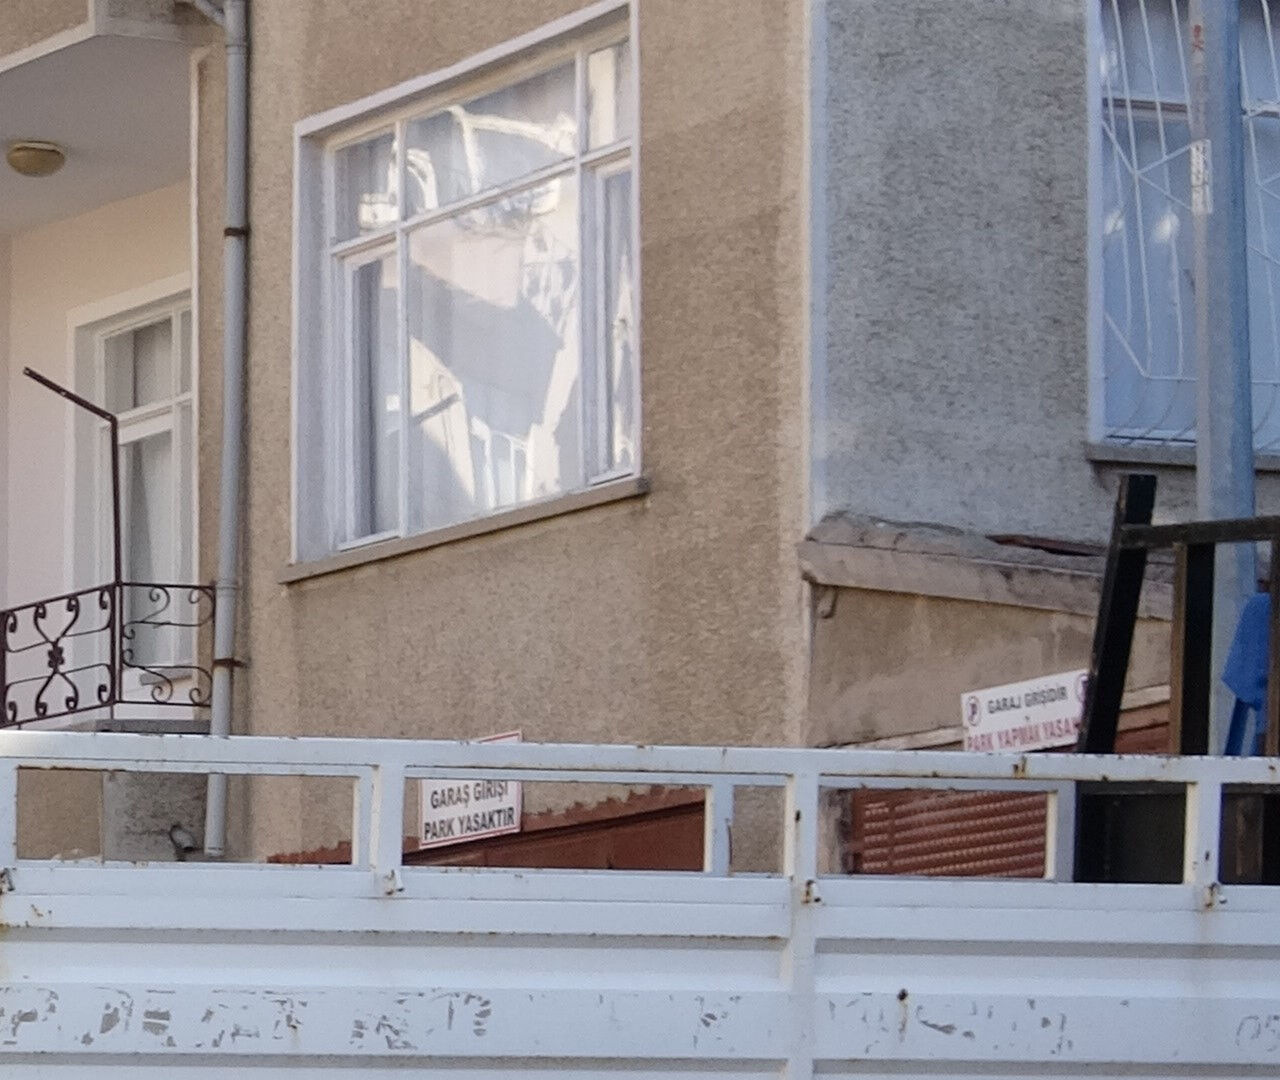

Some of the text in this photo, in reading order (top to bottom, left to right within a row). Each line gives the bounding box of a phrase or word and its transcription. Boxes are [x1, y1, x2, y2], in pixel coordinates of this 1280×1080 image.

[987, 697, 1022, 714] GARAJ
[967, 733, 995, 752] PARK
[998, 724, 1040, 748] YAPMAK
[431, 784, 469, 808] GARAŞ
[424, 807, 514, 840] PARK YASAKTIR
